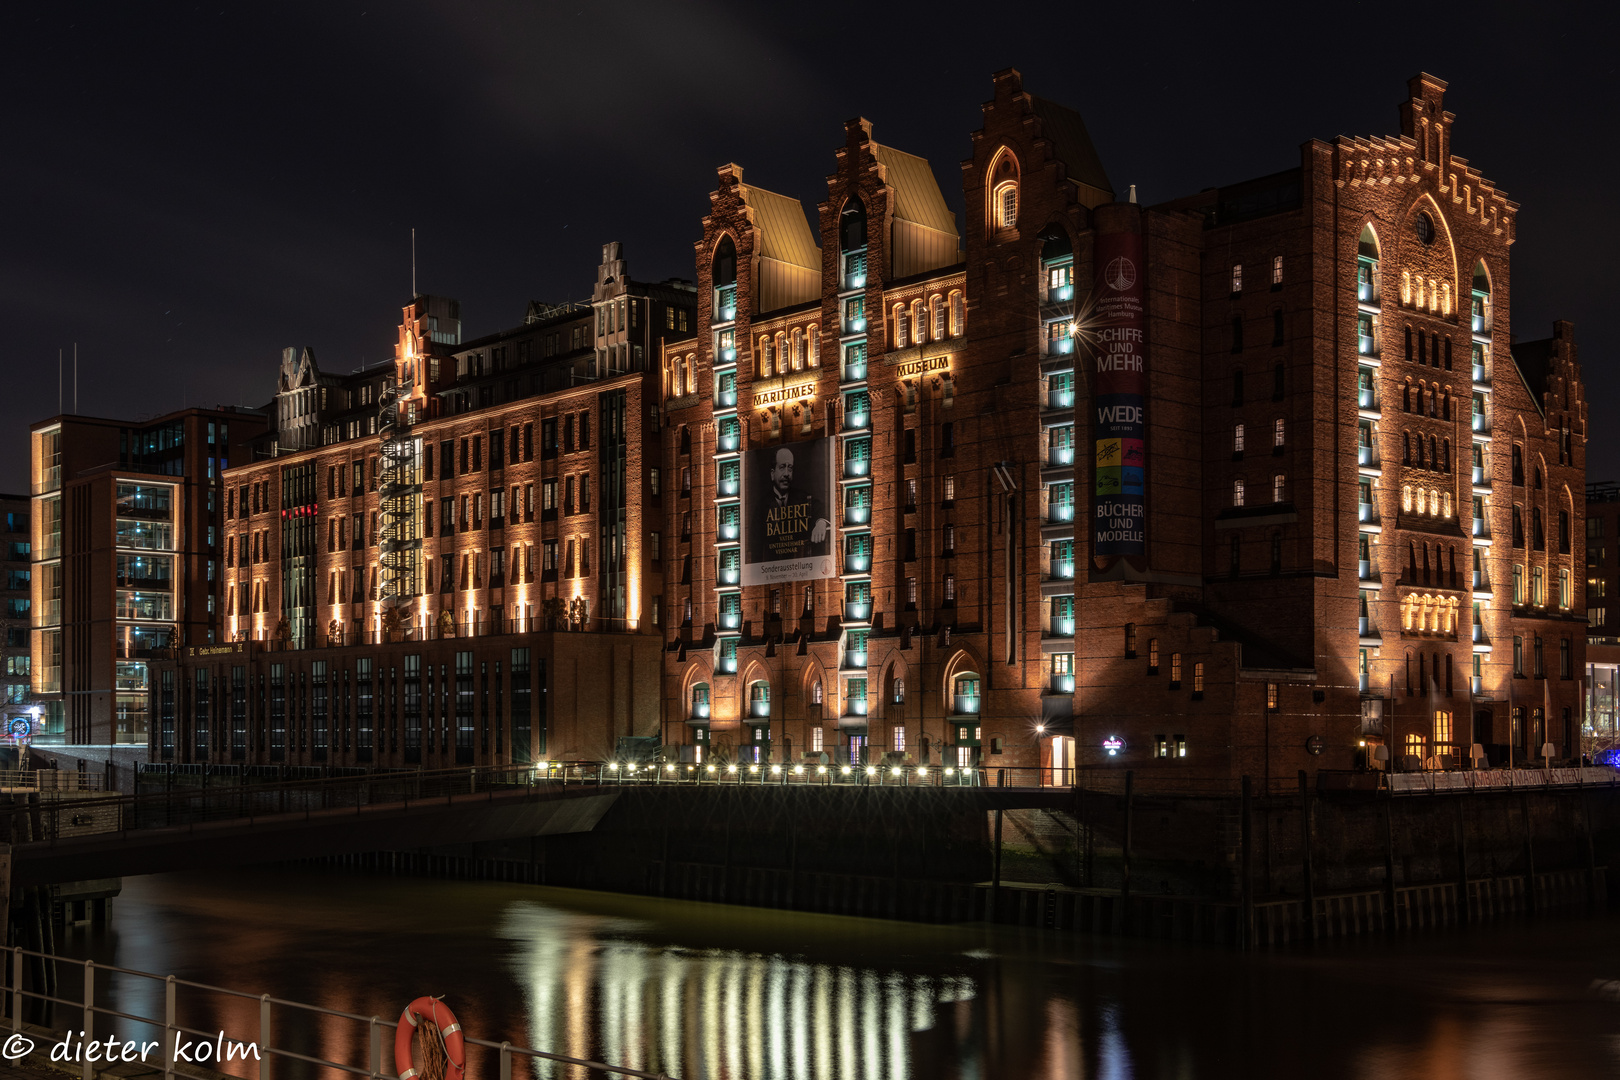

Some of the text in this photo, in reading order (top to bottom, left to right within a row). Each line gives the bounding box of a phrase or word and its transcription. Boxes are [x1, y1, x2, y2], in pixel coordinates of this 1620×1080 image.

[1108, 310, 1135, 319] Hamburg
[1096, 327, 1143, 344] SCHIFFE
[1109, 342, 1133, 354] UND
[896, 355, 949, 378] MUSEUM
[1097, 353, 1143, 373] MEHR
[753, 383, 815, 406] MARITIMES
[1097, 405, 1143, 424] WEDE
[766, 503, 809, 523] ALBERT
[1097, 501, 1143, 518] BÜCHER
[766, 517, 809, 537] BALLIN
[1109, 518, 1134, 529] UND
[1097, 531, 1144, 543] MODELLE
[761, 561, 813, 574] Sonderausstellung
[1561, 768, 1580, 784] HERZ
